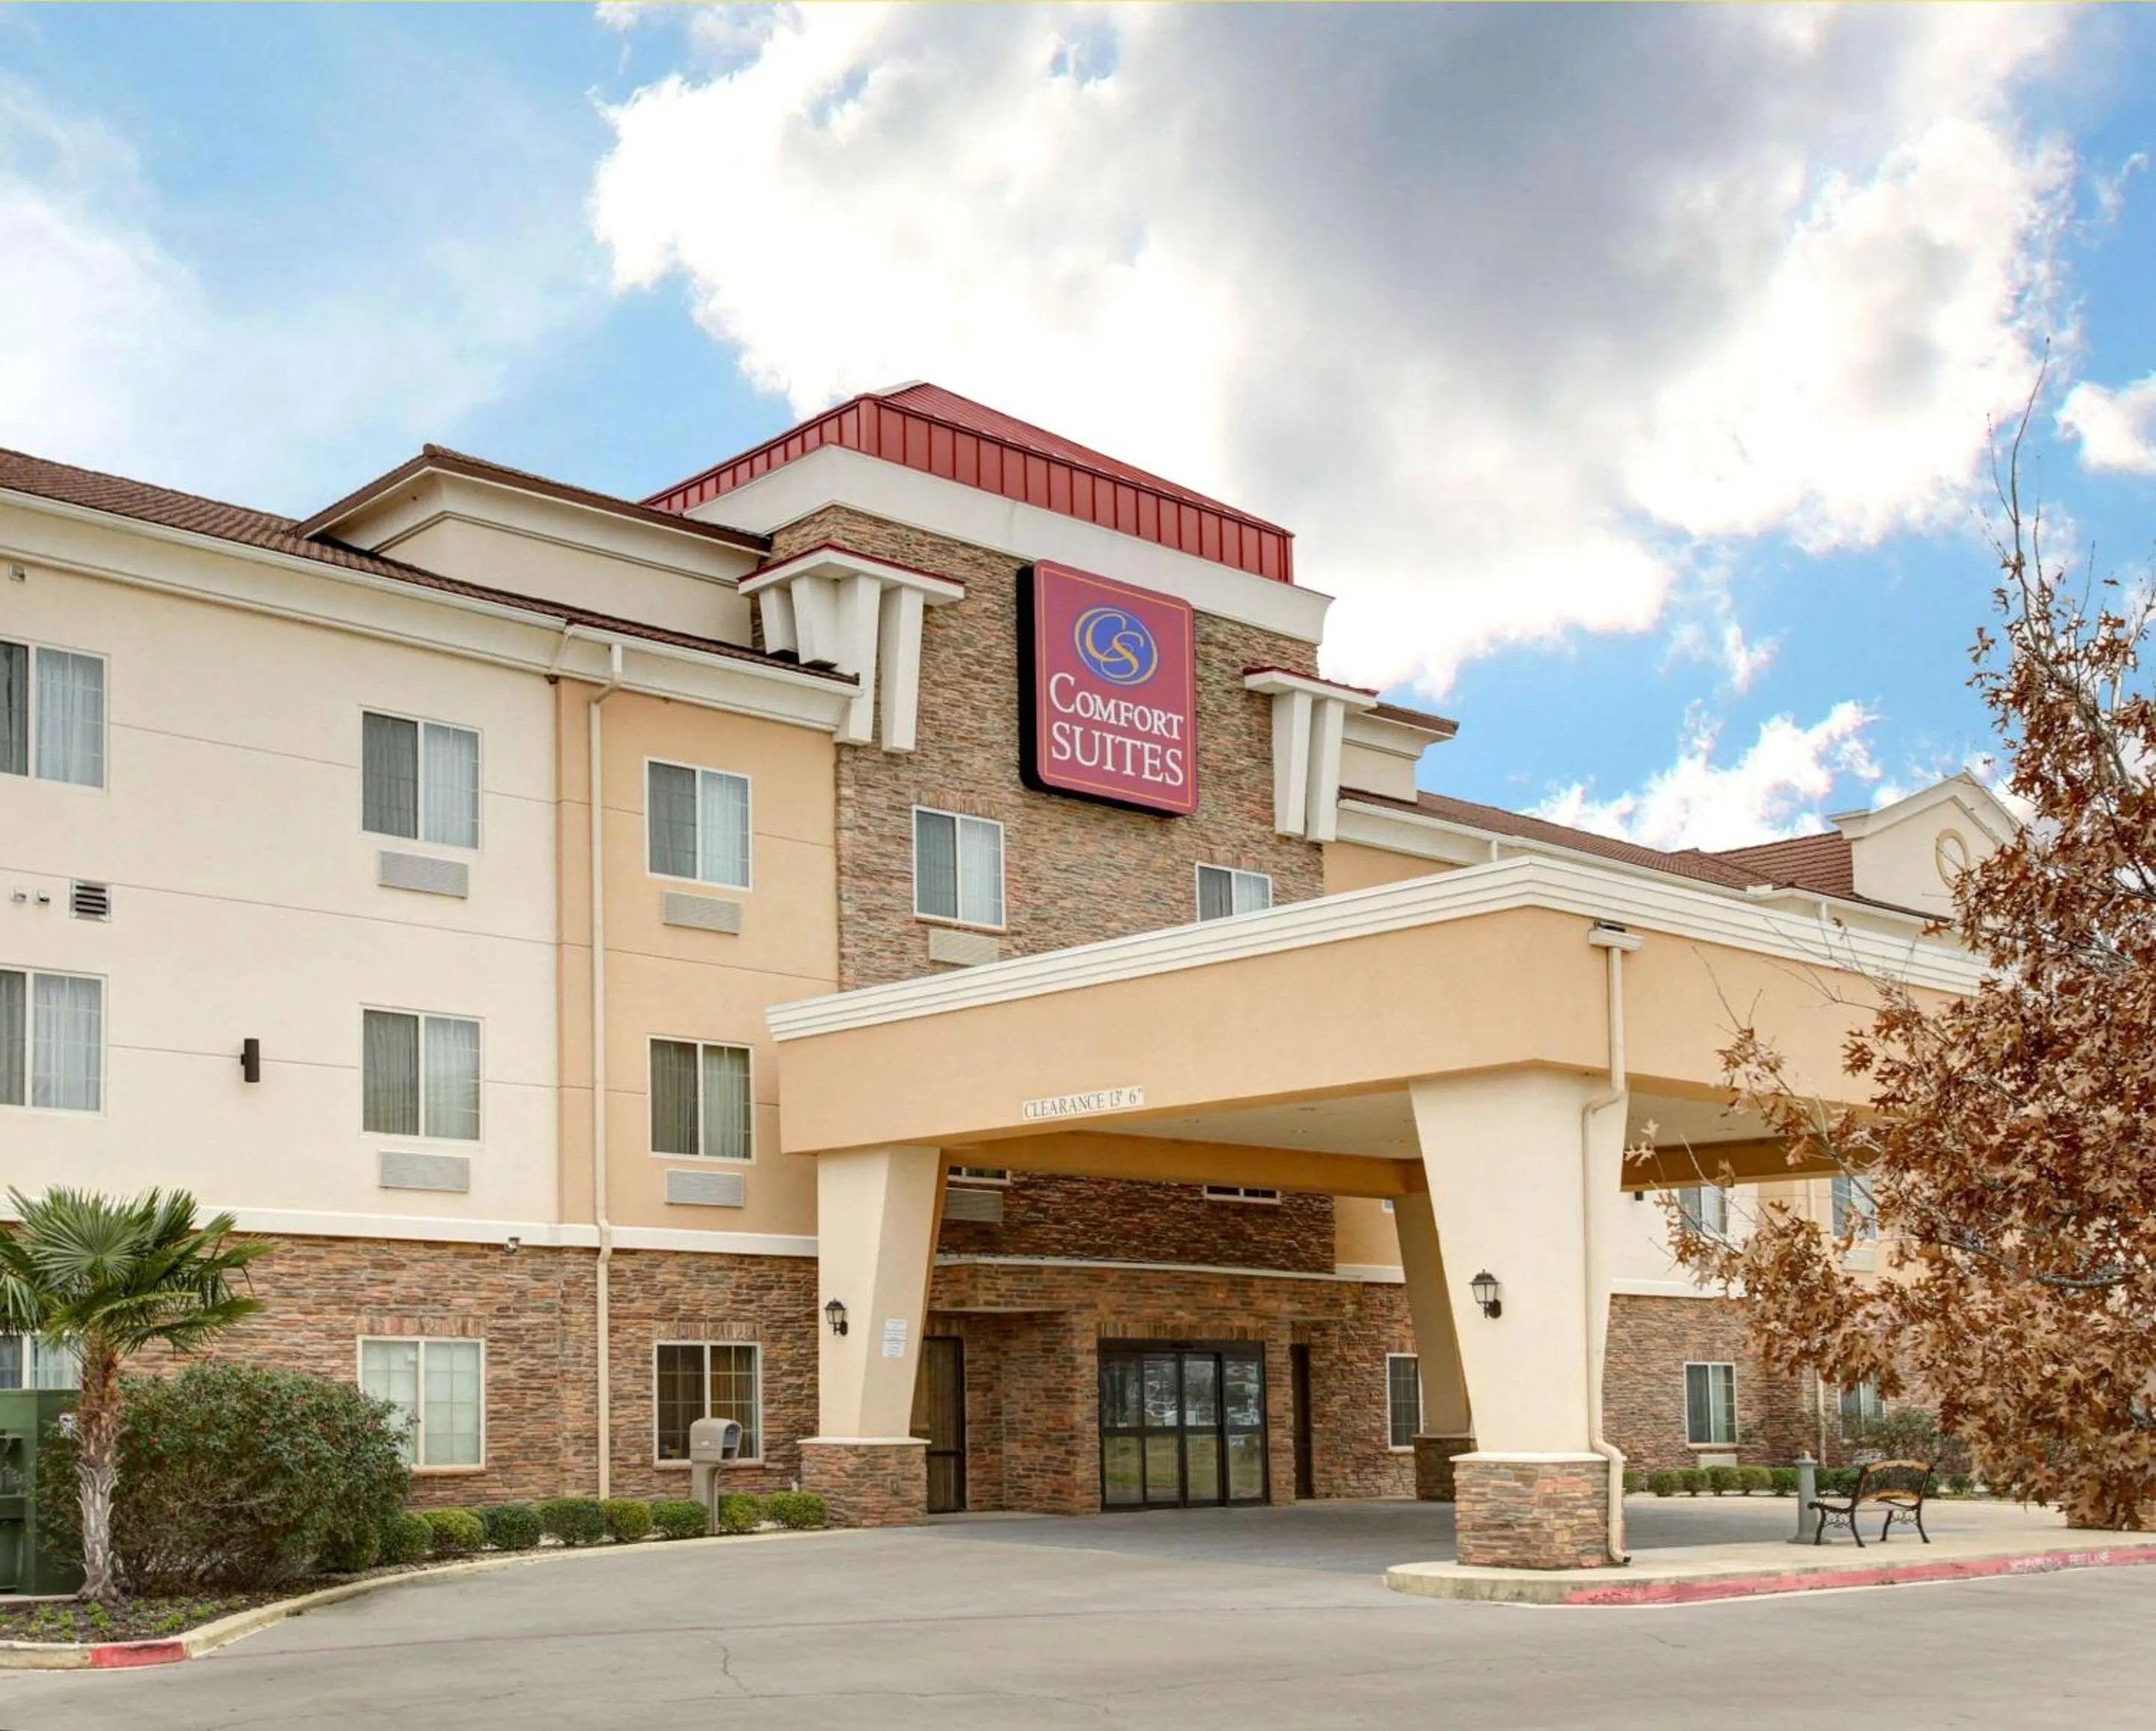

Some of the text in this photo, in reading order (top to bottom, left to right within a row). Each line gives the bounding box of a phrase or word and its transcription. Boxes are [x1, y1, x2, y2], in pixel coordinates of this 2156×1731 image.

[1050, 673, 1184, 739] COMFORT
[1051, 721, 1184, 786] SUITES
[1024, 1093, 1105, 1118] CLEARANCE
